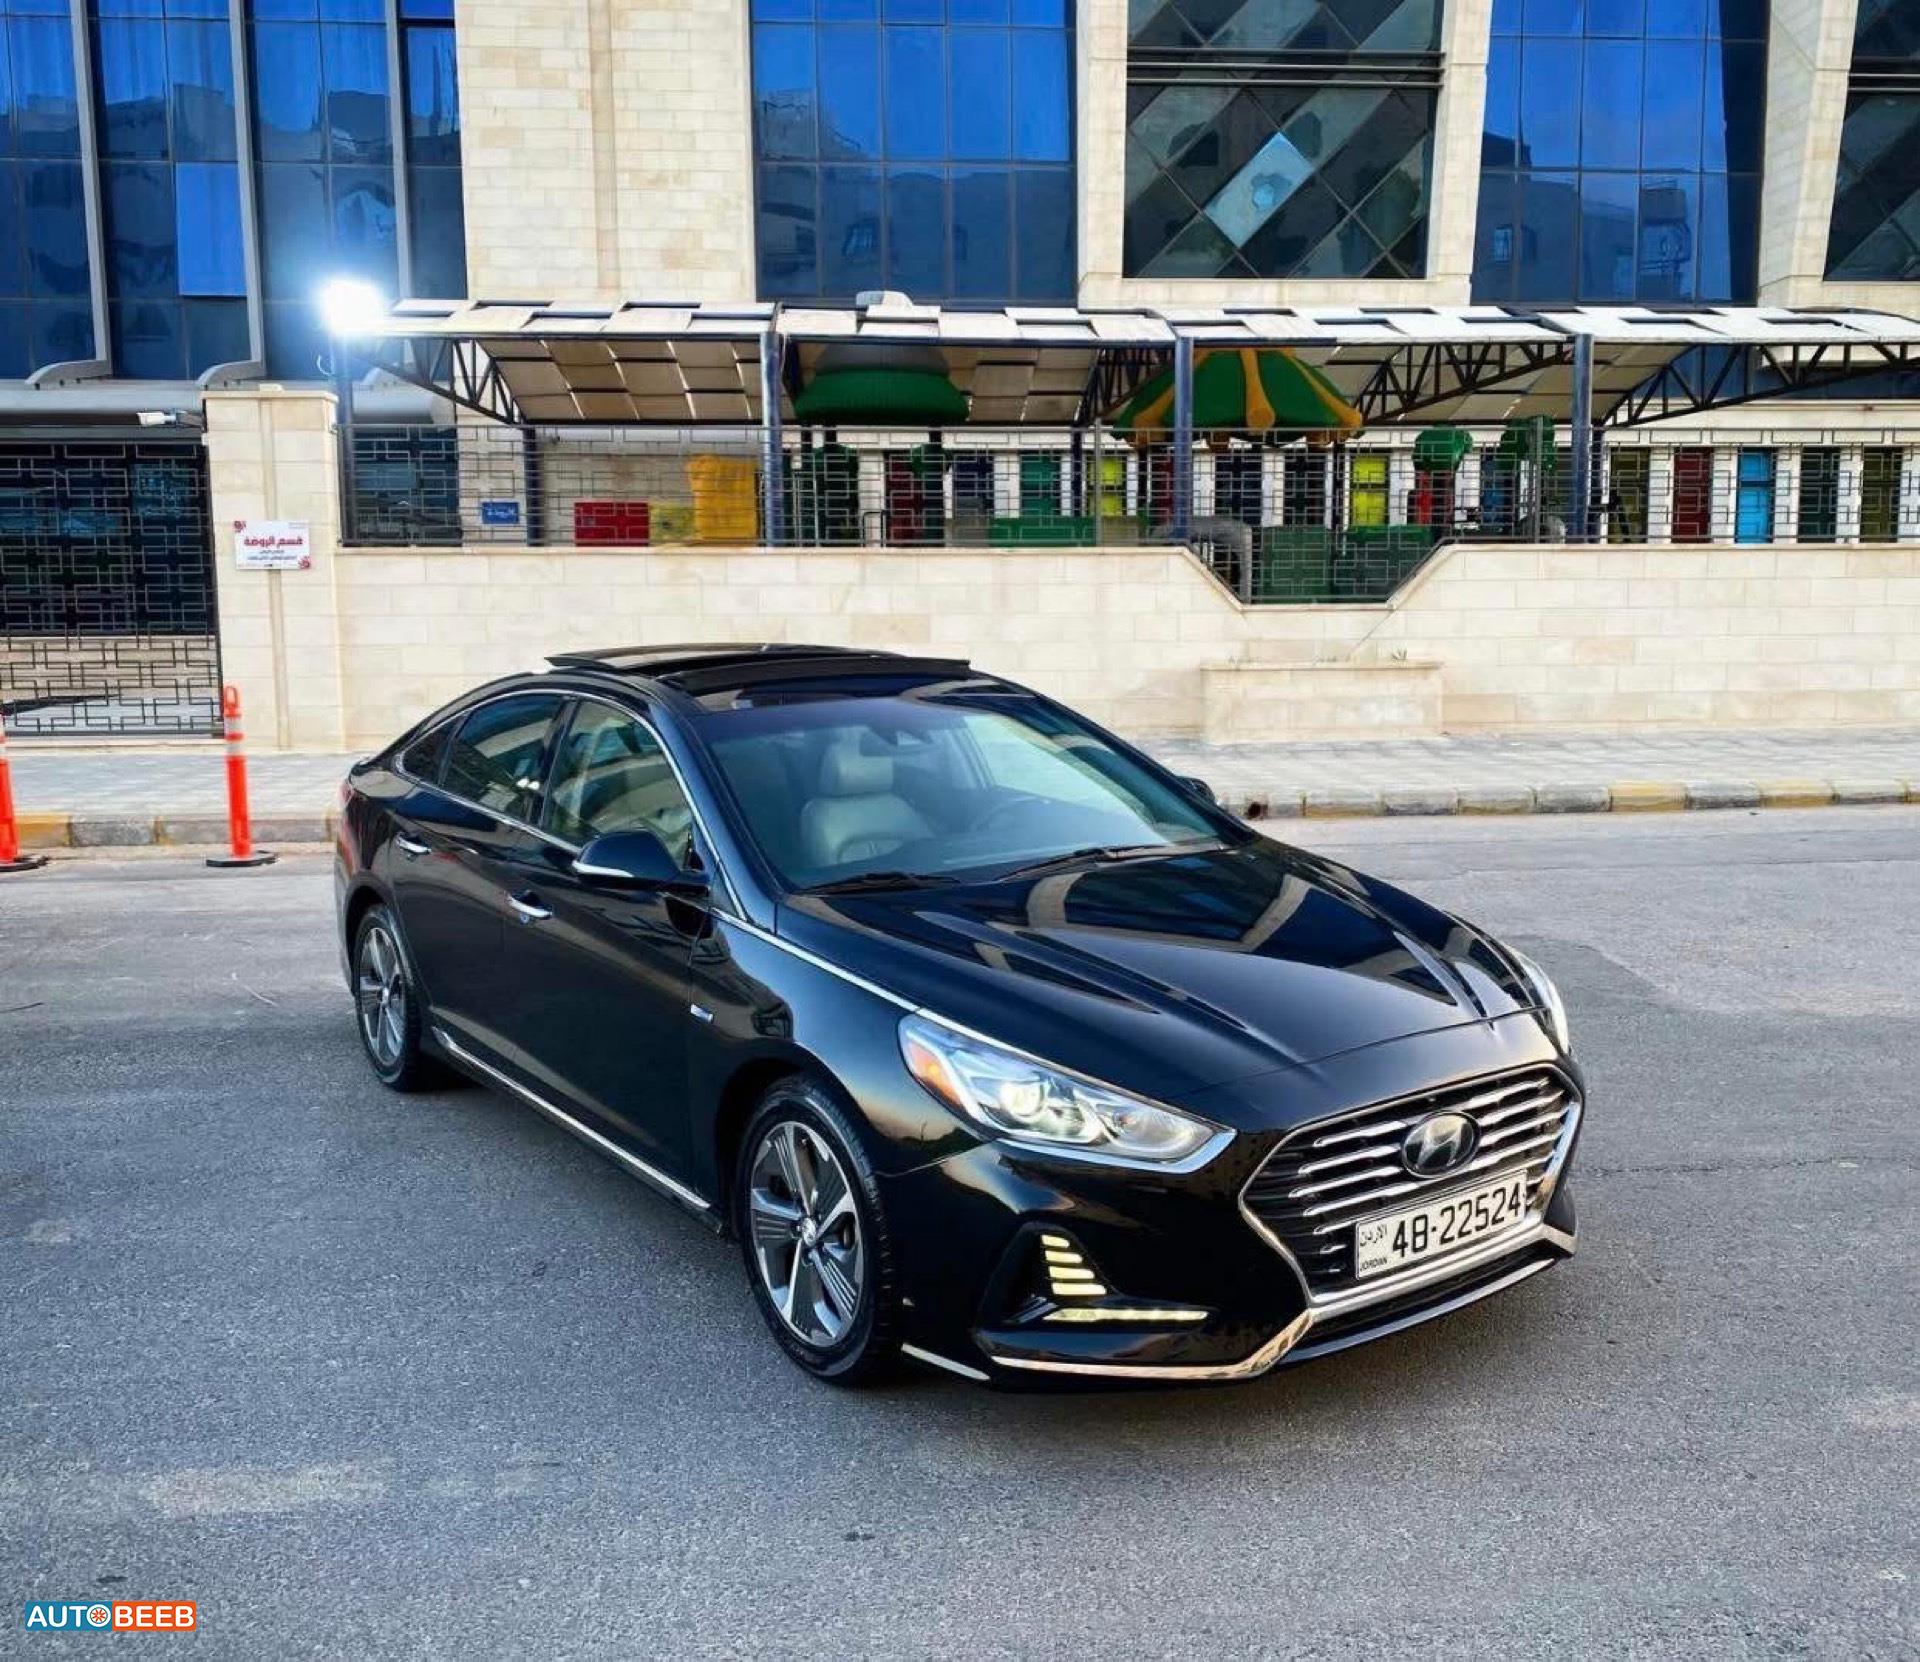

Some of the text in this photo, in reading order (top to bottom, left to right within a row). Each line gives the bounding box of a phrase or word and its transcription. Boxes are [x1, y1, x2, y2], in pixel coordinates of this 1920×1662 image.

[243, 535, 303, 548] قسم الروضة
[1360, 1256, 1388, 1272] JORDAN
